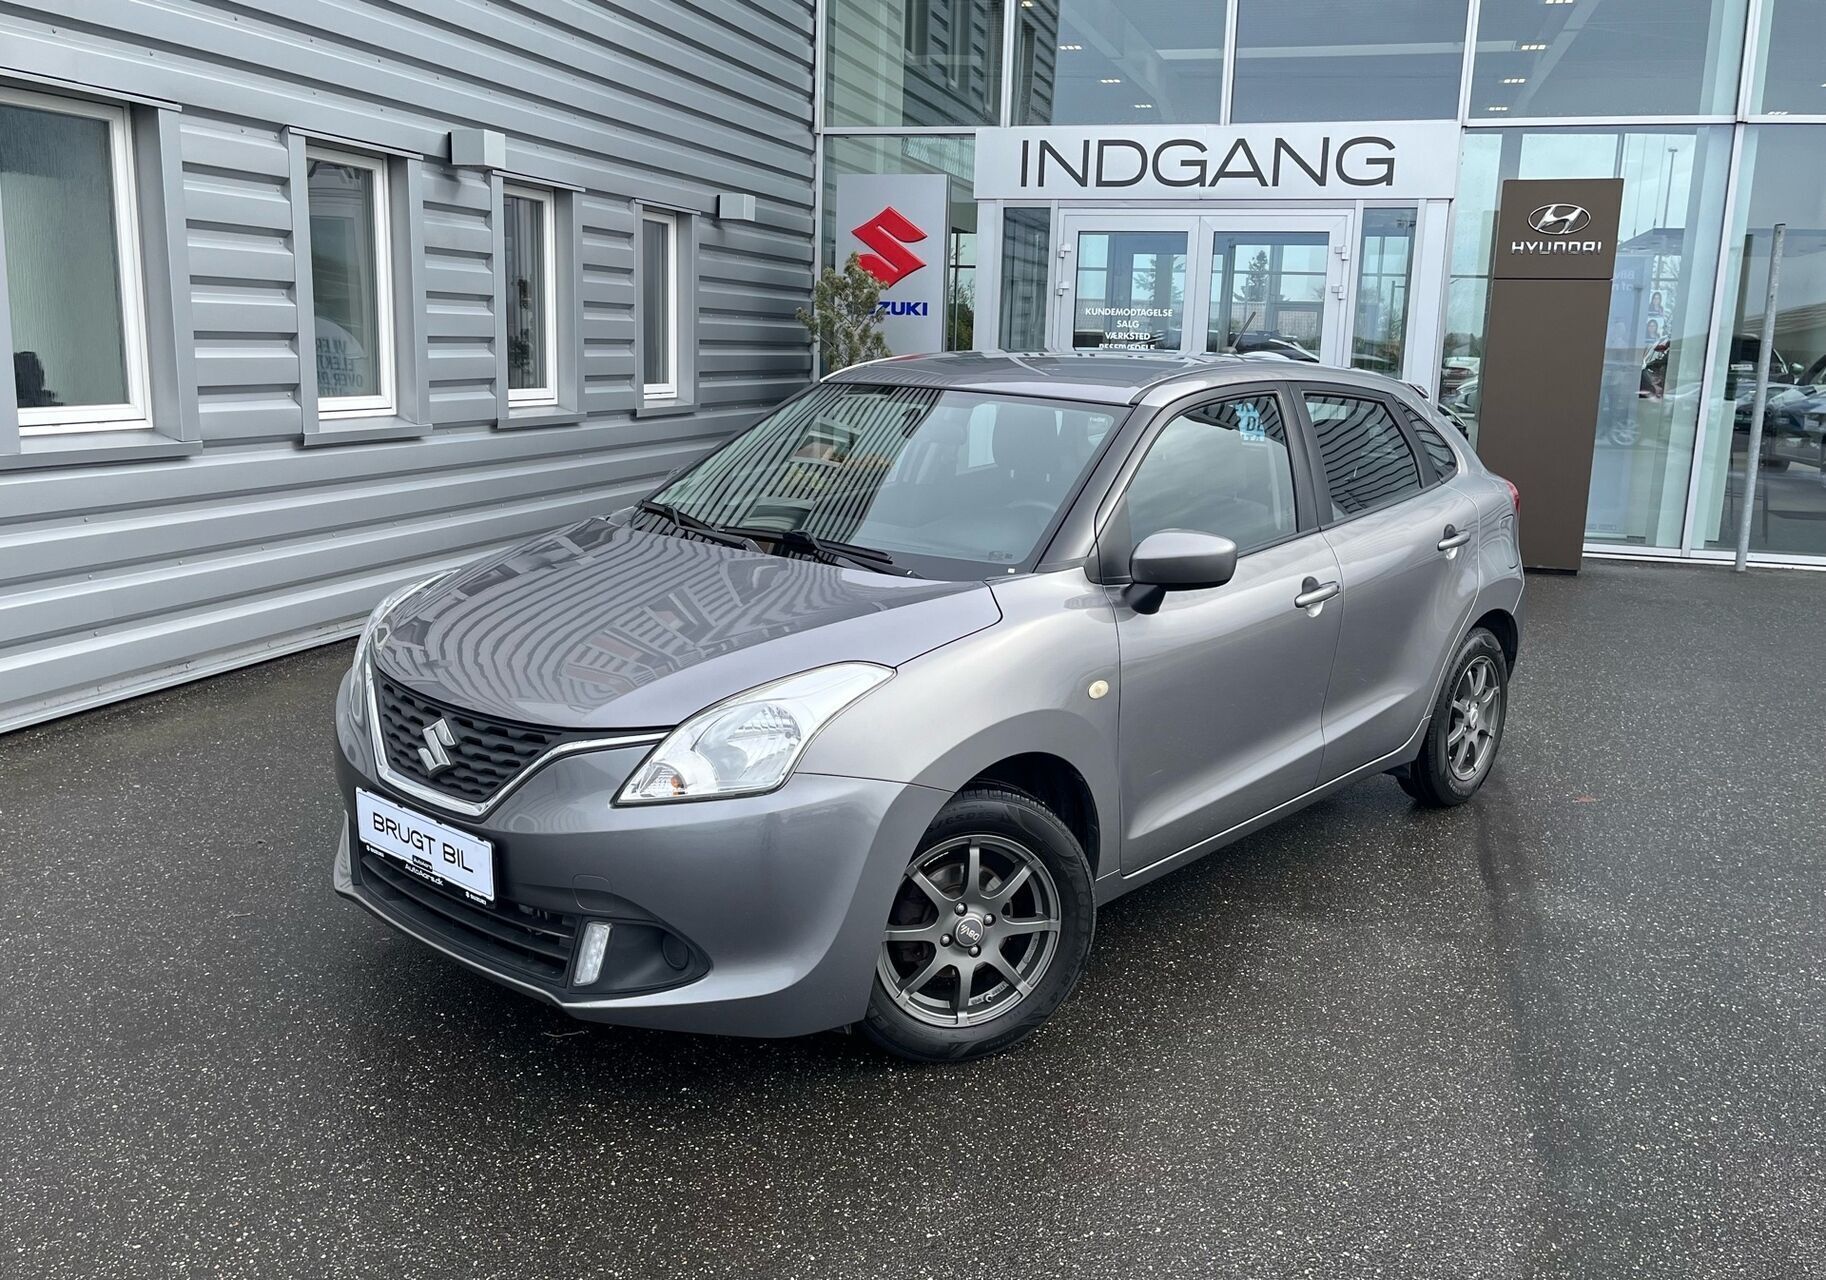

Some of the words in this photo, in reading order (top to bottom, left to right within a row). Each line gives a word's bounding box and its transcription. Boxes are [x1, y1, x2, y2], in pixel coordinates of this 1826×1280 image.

[1020, 136, 1396, 188] INDGANG
[1511, 241, 1602, 255] HYUNDAI
[869, 301, 928, 316] ZUKI
[1085, 307, 1173, 317] KUNDEMODTAGELSE
[1116, 320, 1140, 328] SALG
[1105, 331, 1151, 340] VÆRKSTED
[373, 812, 436, 855] BRUGT
[442, 842, 474, 873] BIL
